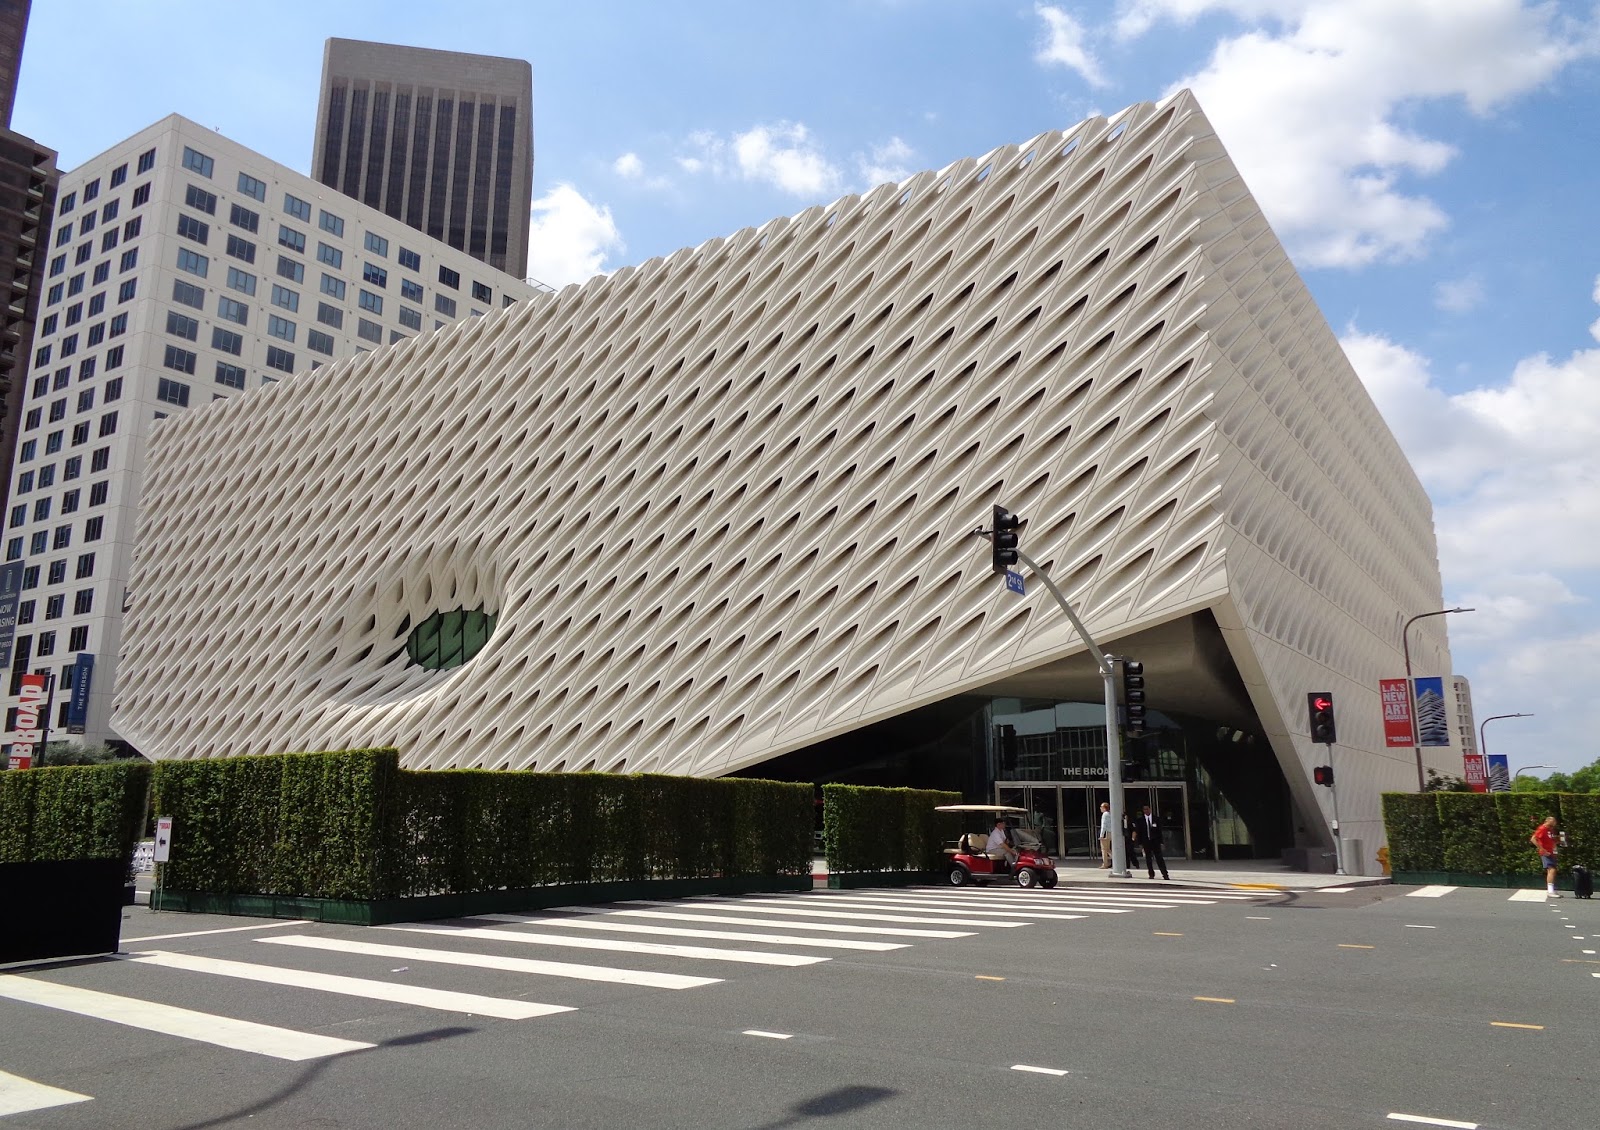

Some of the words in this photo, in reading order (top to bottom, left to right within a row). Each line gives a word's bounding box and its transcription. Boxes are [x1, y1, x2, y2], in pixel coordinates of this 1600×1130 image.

[1382, 692, 1406, 701] NEW
[1385, 704, 1408, 715] ART
[10, 685, 43, 758] BROAD
[1062, 767, 1081, 775] THE
[1083, 767, 1109, 775] BROA
